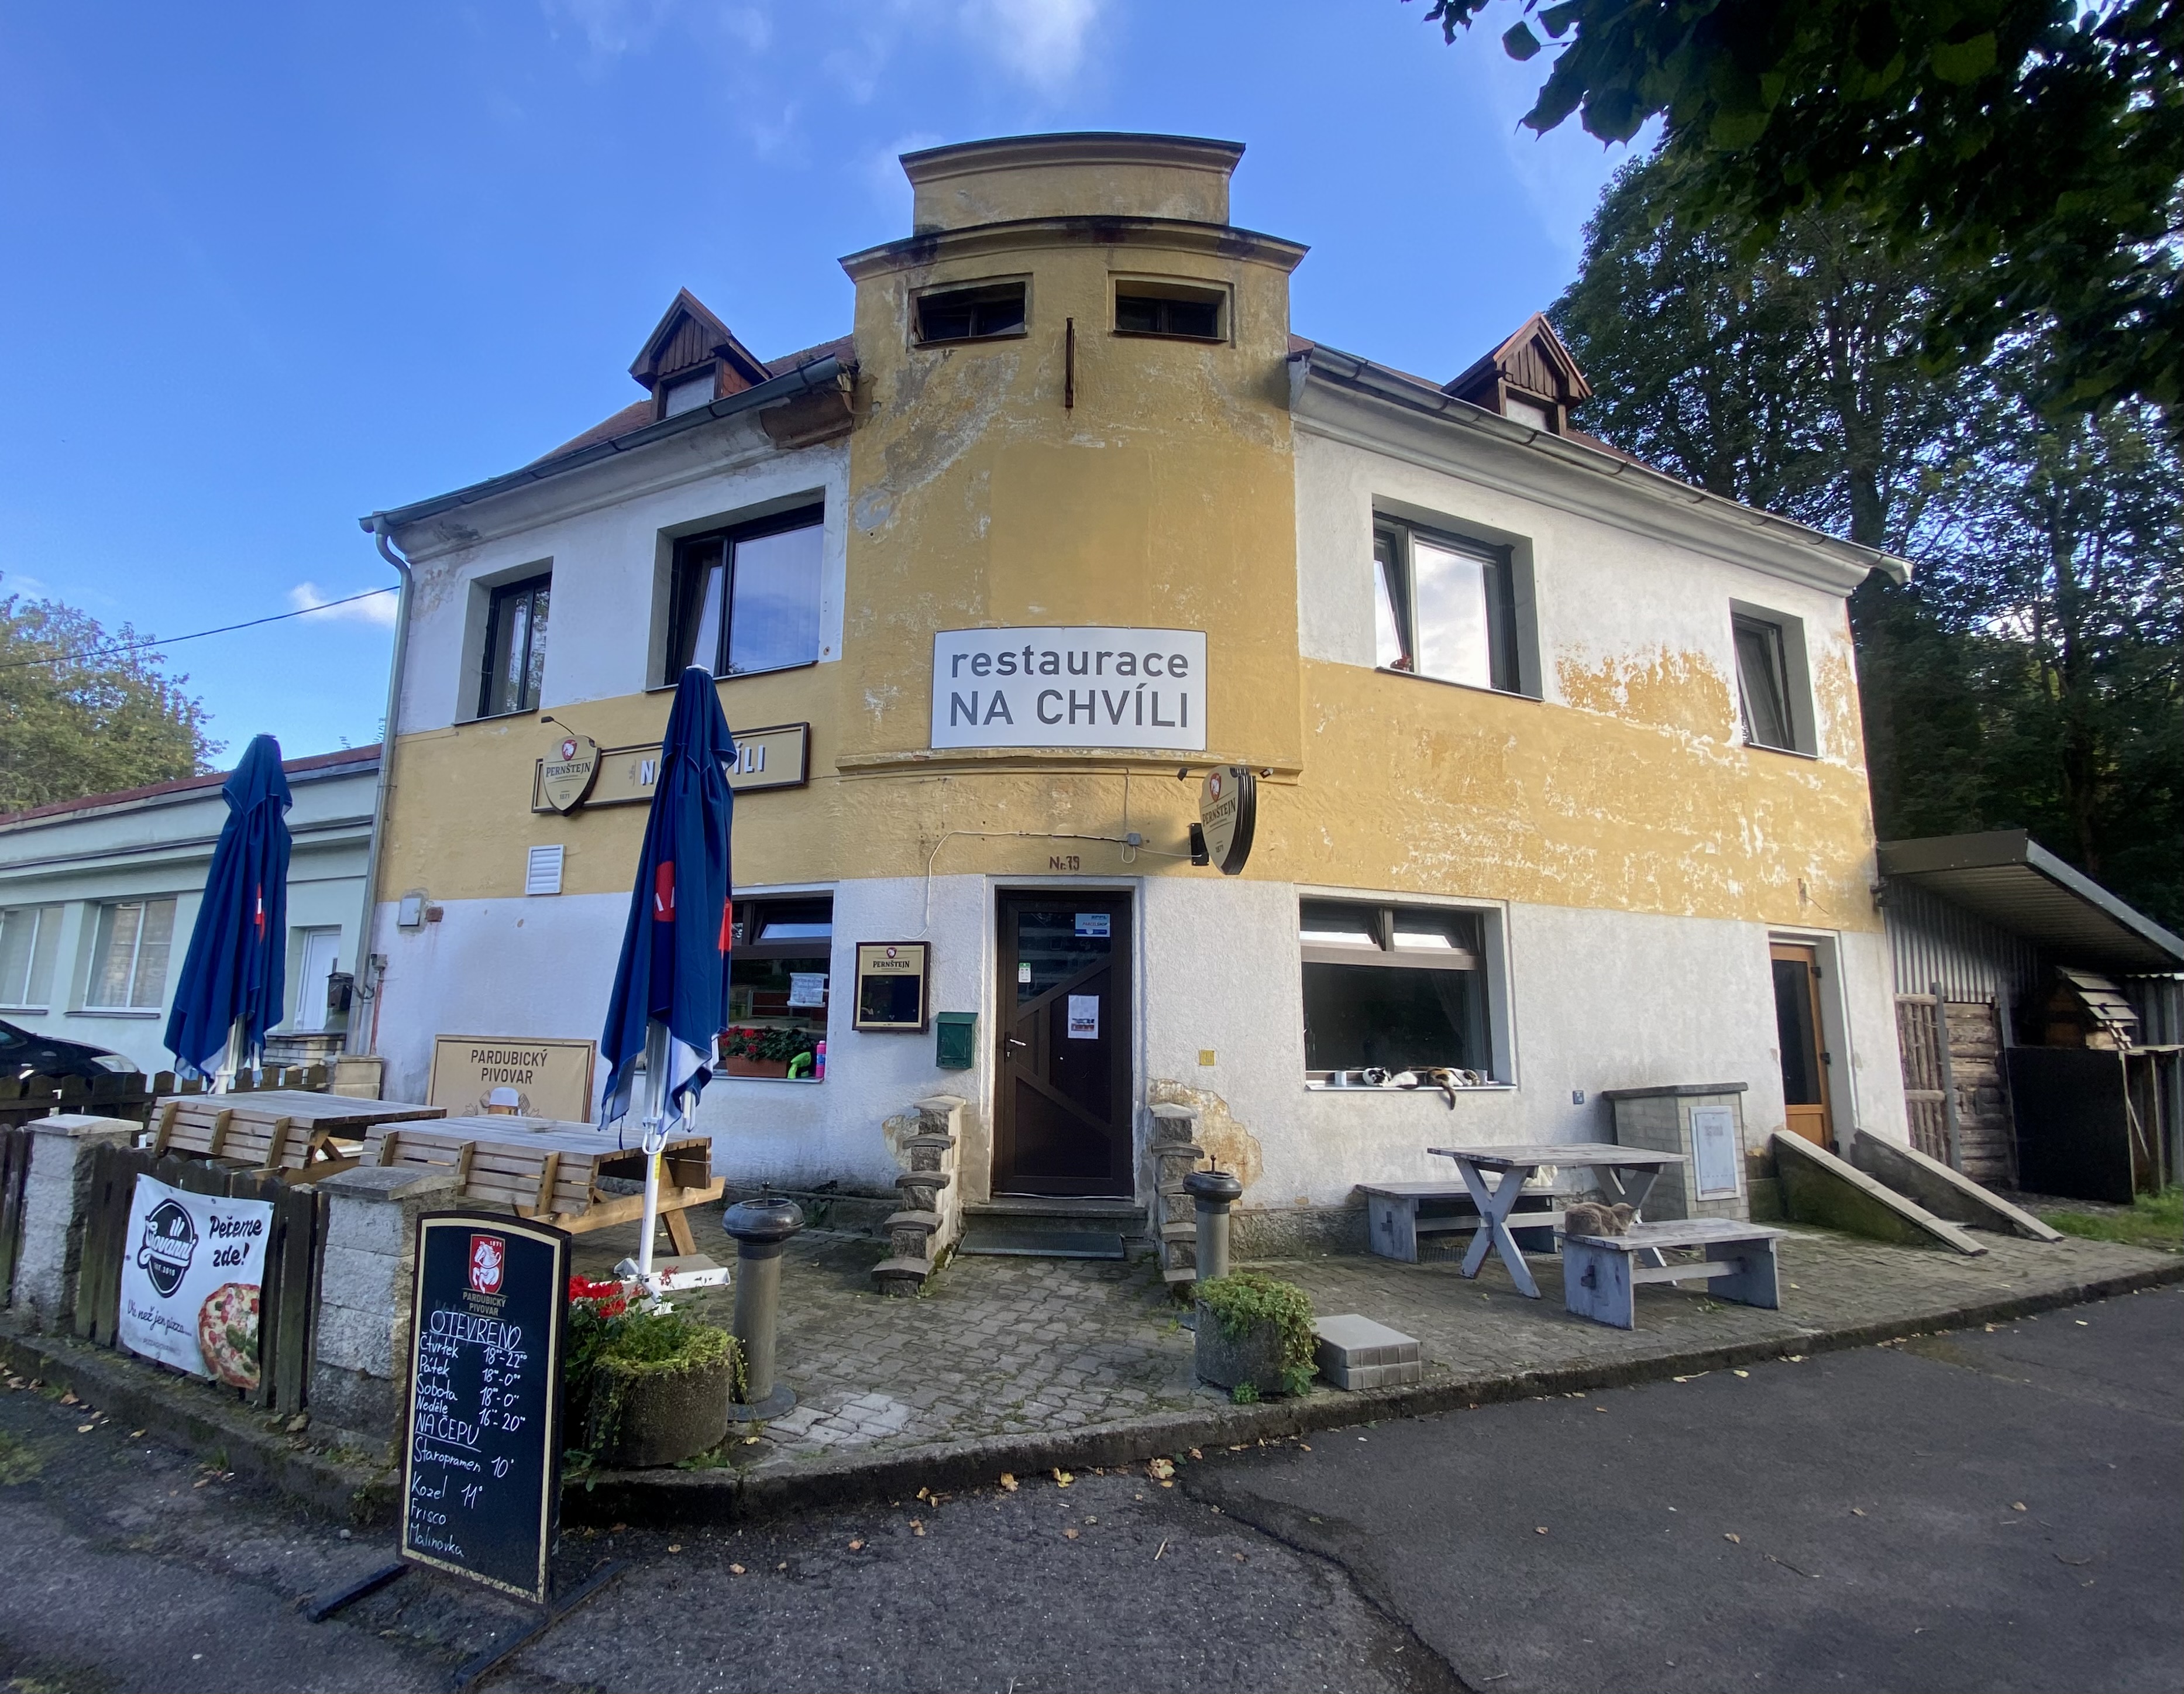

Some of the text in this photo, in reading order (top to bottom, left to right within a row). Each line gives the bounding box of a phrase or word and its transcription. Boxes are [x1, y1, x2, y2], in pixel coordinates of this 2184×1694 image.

[951, 645, 1188, 678] restaurace
[950, 683, 1188, 728] NA CHVÍLI
[546, 761, 591, 777] PERNŠTEJN
[1202, 797, 1236, 827] PERNŠTEJN
[873, 960, 910, 968] PERNŠTEJN
[470, 1049, 548, 1067] PARDUBICKÝ
[481, 1068, 533, 1084] PIVOVAR
[209, 1215, 262, 1239] Pečeme
[212, 1242, 249, 1267] zde!
[463, 1291, 507, 1307] PARDUBICKÝ
[469, 1303, 499, 1316] PIVOVAR
[137, 1305, 155, 1322] než
[150, 1311, 166, 1331] jen
[431, 1310, 522, 1351] OTEVŘENO
[420, 1331, 459, 1359] Čtvrtek
[419, 1354, 450, 1378] Pátek
[417, 1373, 458, 1401] Sobota
[416, 1395, 448, 1414] Neděle
[416, 1412, 480, 1445] NA ČEPU
[414, 1436, 481, 1473] Staropramen
[411, 1470, 448, 1499] Kozel
[411, 1497, 446, 1525] Frisco
[409, 1522, 465, 1558] Malinovka
